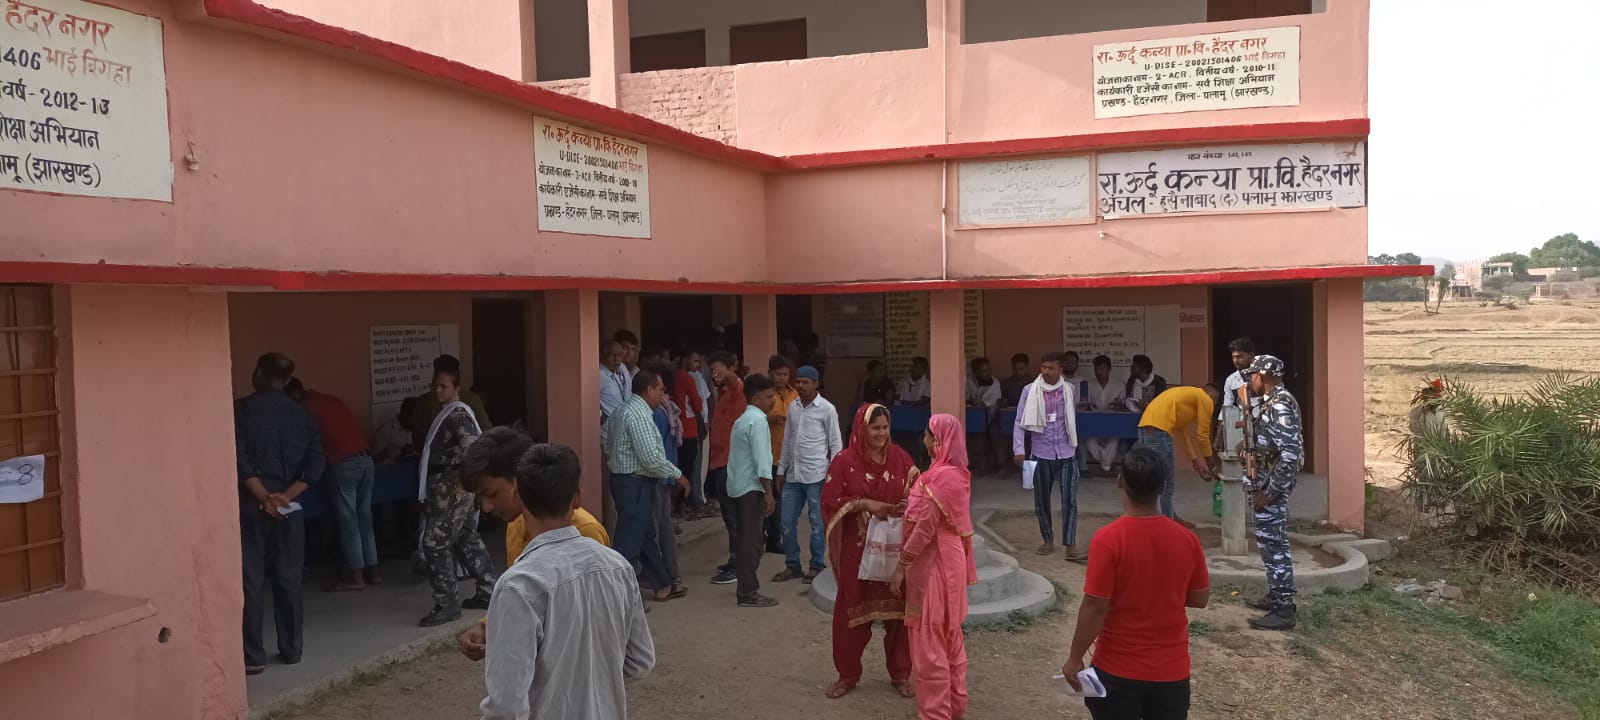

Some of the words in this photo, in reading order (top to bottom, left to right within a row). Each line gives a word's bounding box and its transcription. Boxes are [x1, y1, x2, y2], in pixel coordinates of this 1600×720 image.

[59, 14, 114, 49] नगर
[0, 46, 42, 70] 406
[1139, 46, 1172, 60] कन्या
[30, 117, 100, 150] अभियान
[1164, 167, 1242, 192] कन्या
[1280, 190, 1333, 204] झारखण्ड
